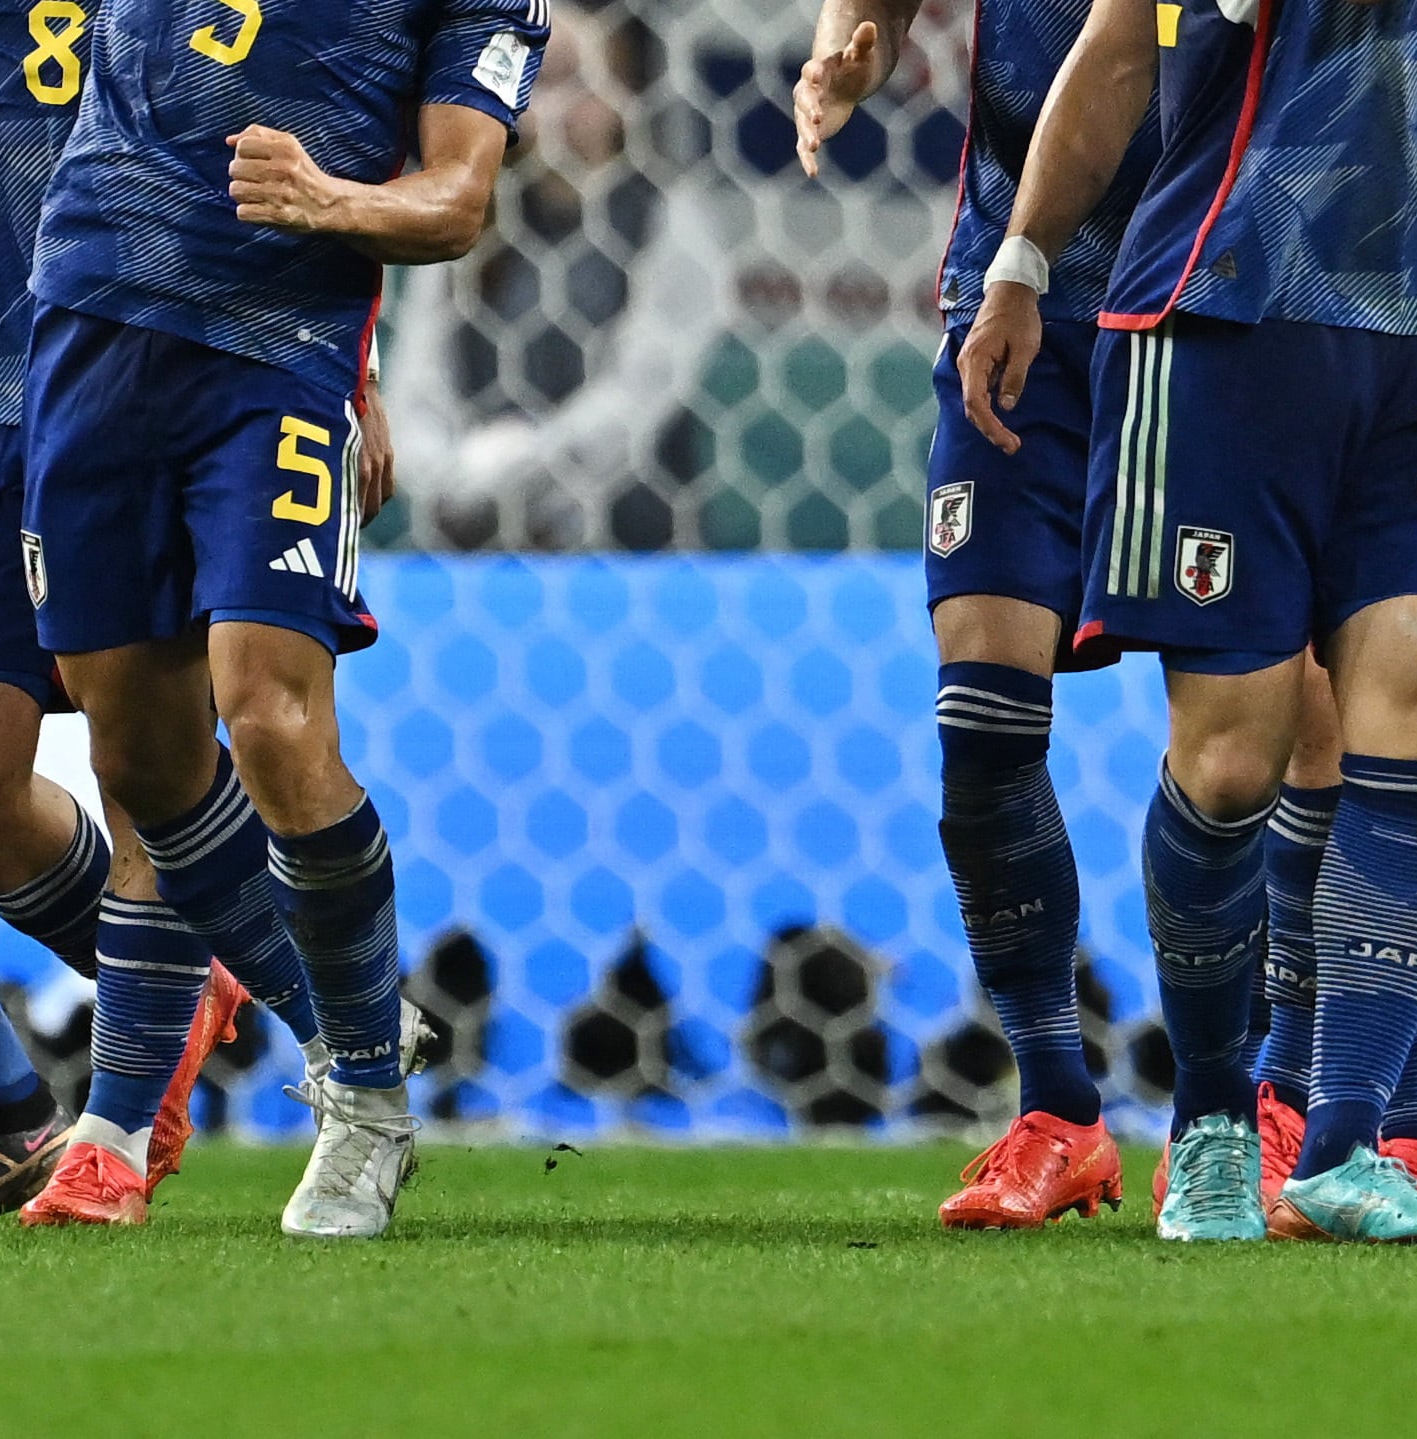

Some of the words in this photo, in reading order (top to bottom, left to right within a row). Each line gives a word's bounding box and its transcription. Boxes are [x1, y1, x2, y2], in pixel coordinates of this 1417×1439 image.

[23, 0, 87, 106] 8
[271, 416, 333, 525] 5
[1192, 529, 1222, 540] JAPAN
[964, 898, 1045, 929] PAN
[1153, 918, 1263, 966] APAN
[320, 1040, 392, 1062] PAN
